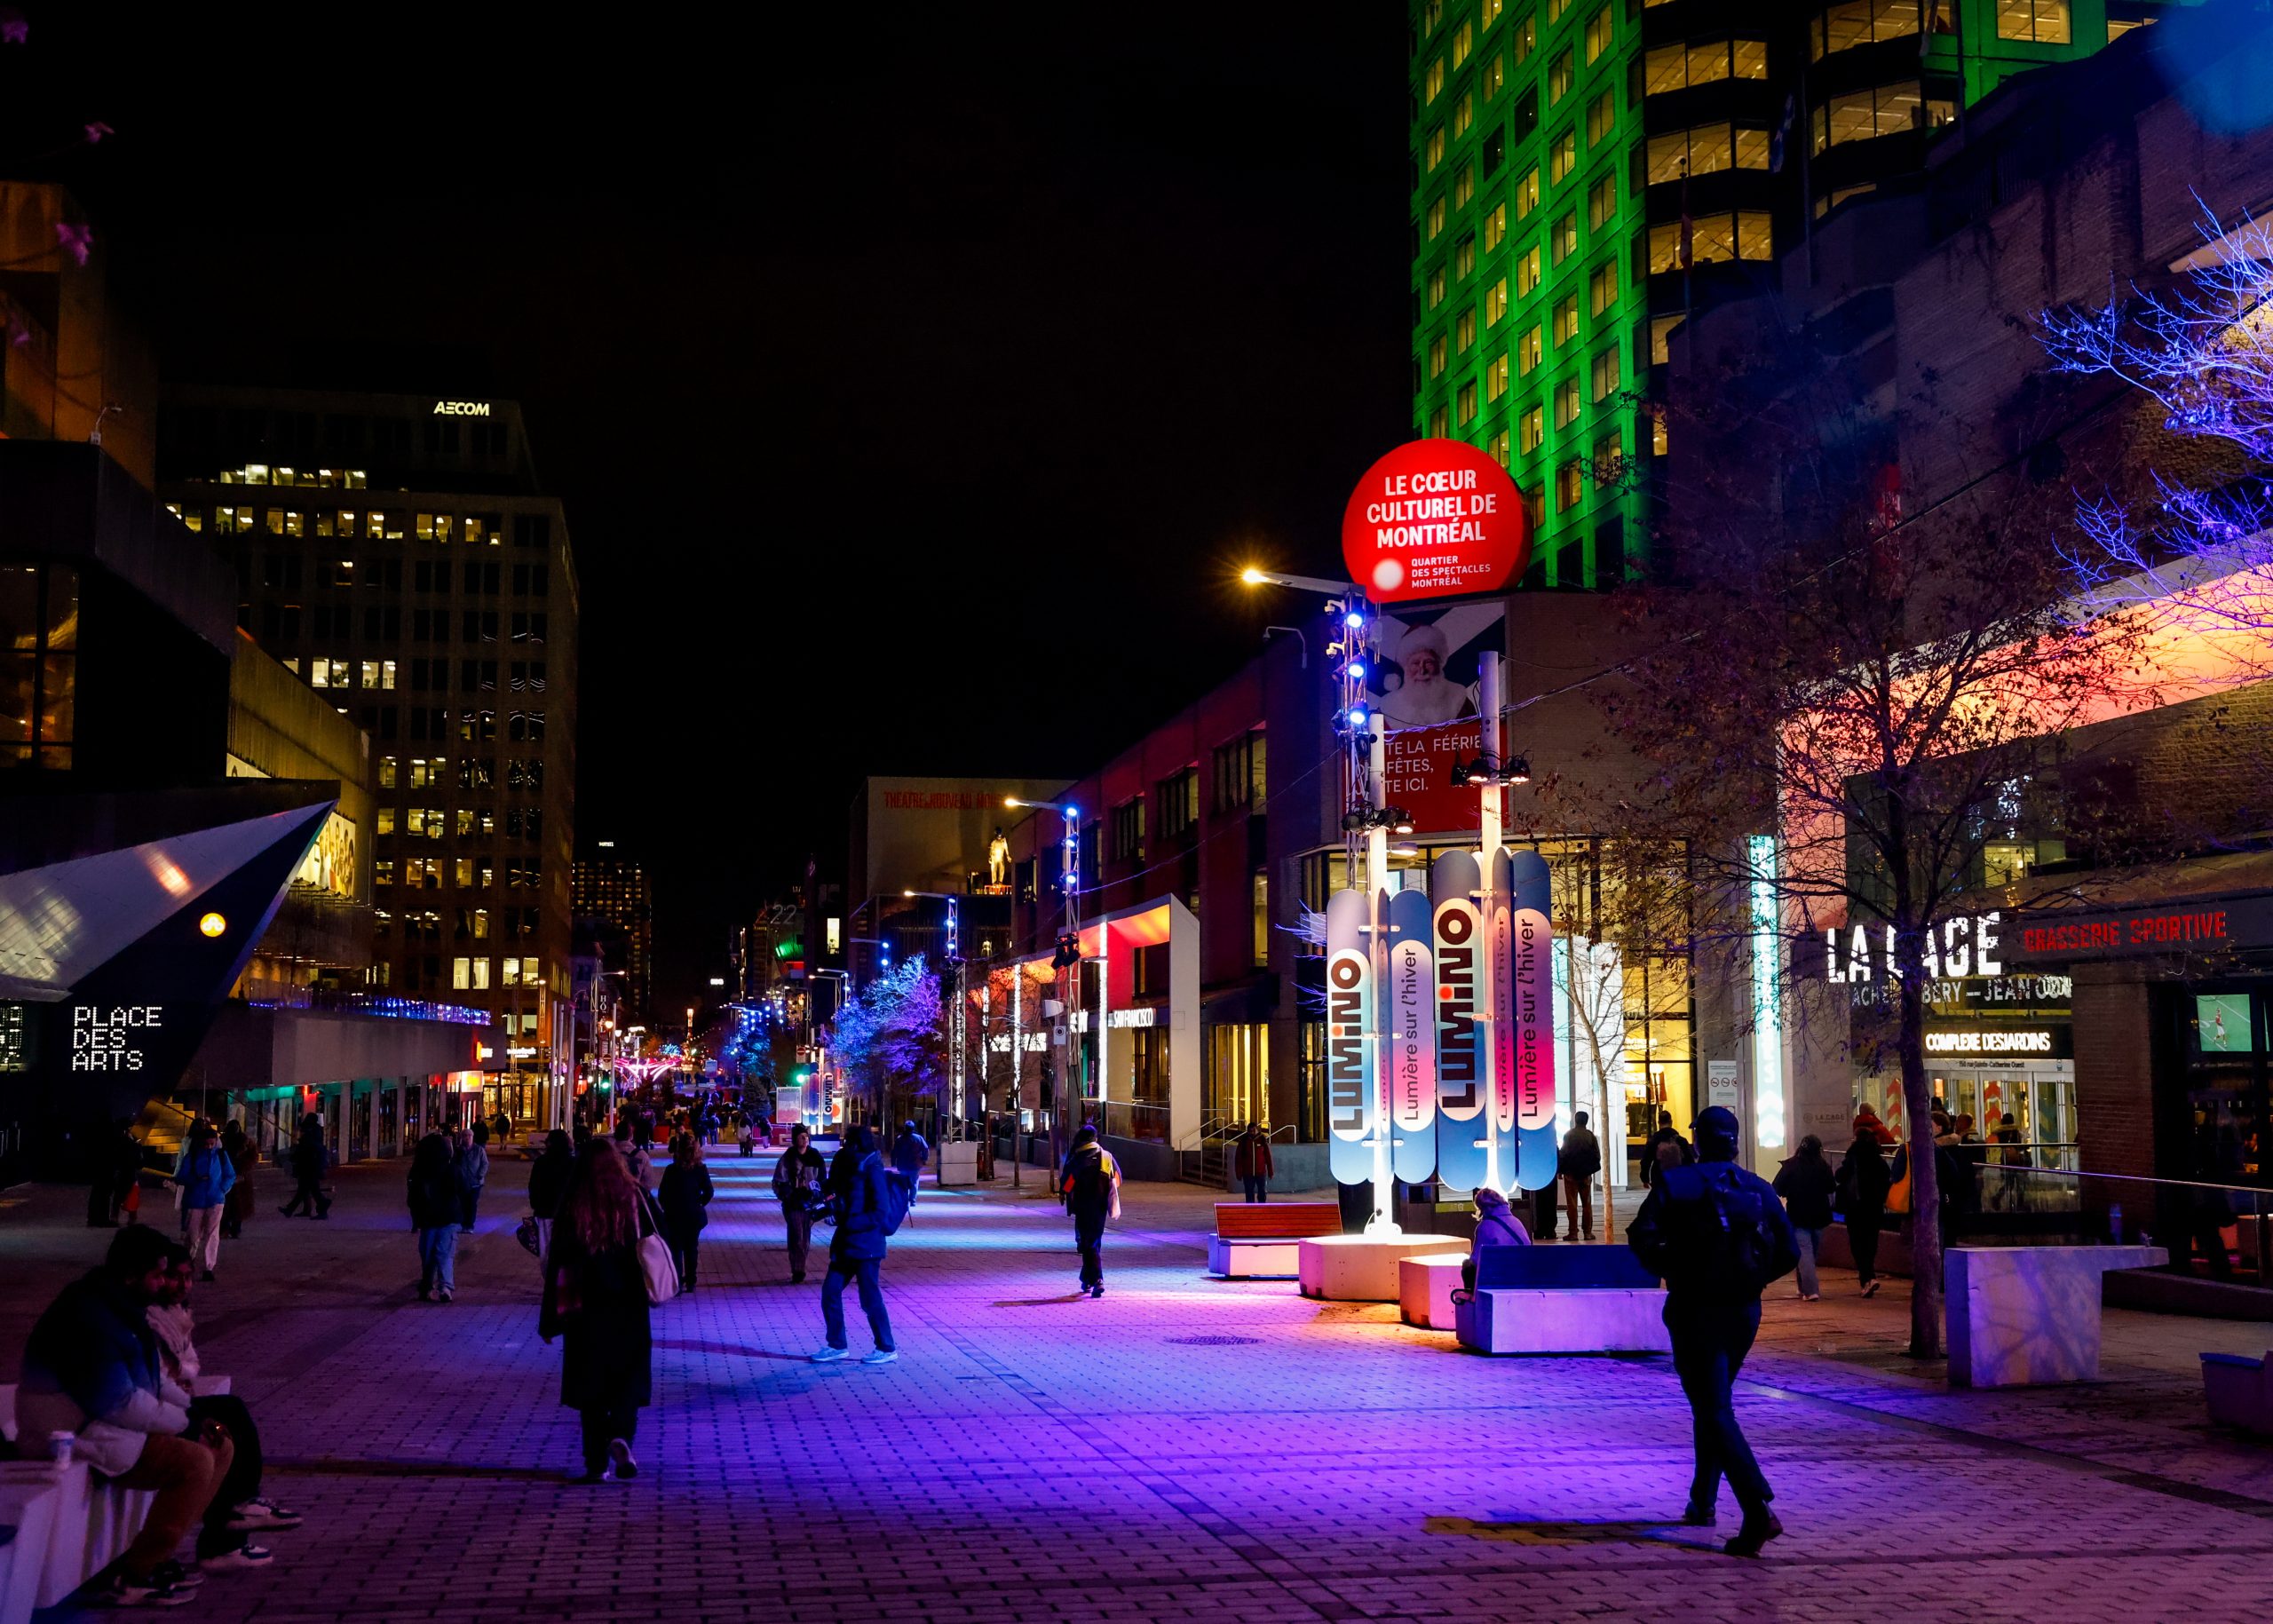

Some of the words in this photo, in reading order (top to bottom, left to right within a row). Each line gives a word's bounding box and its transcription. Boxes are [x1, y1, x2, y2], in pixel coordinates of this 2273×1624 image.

[433, 400, 490, 416] AECOM
[1385, 475, 1407, 496] LE
[1411, 469, 1477, 494] CŒUR
[1366, 495, 1467, 524] CULTUREL
[1470, 493, 1497, 516] DE
[1377, 517, 1486, 549] MONTRÉAL
[1411, 555, 1459, 567] QUARTIER
[1411, 568, 1430, 578] DES
[1432, 564, 1491, 577] SPECTACLES
[1411, 574, 1463, 588] MONTRÉAL
[1407, 740, 1425, 754] LA
[1387, 757, 1434, 774] FÊTES,
[1406, 777, 1429, 792] ICI.
[2130, 911, 2227, 944] SPORTIVE
[1517, 918, 1535, 985] l'hiver
[1826, 923, 1872, 984] LA
[1400, 948, 1418, 1006] l'hiver
[74, 1006, 162, 1027] PLACE
[1521, 990, 1536, 1024] sur
[1404, 1010, 1418, 1040] sur
[73, 1028, 126, 1049] DES
[1925, 1033, 1982, 1051] COMPLEXE
[1982, 1032, 2051, 1051] DESJARDINS
[72, 1050, 143, 1071] ARTS
[1401, 1043, 1419, 1121] Lumière
[1517, 1029, 1538, 1118] Lumière
